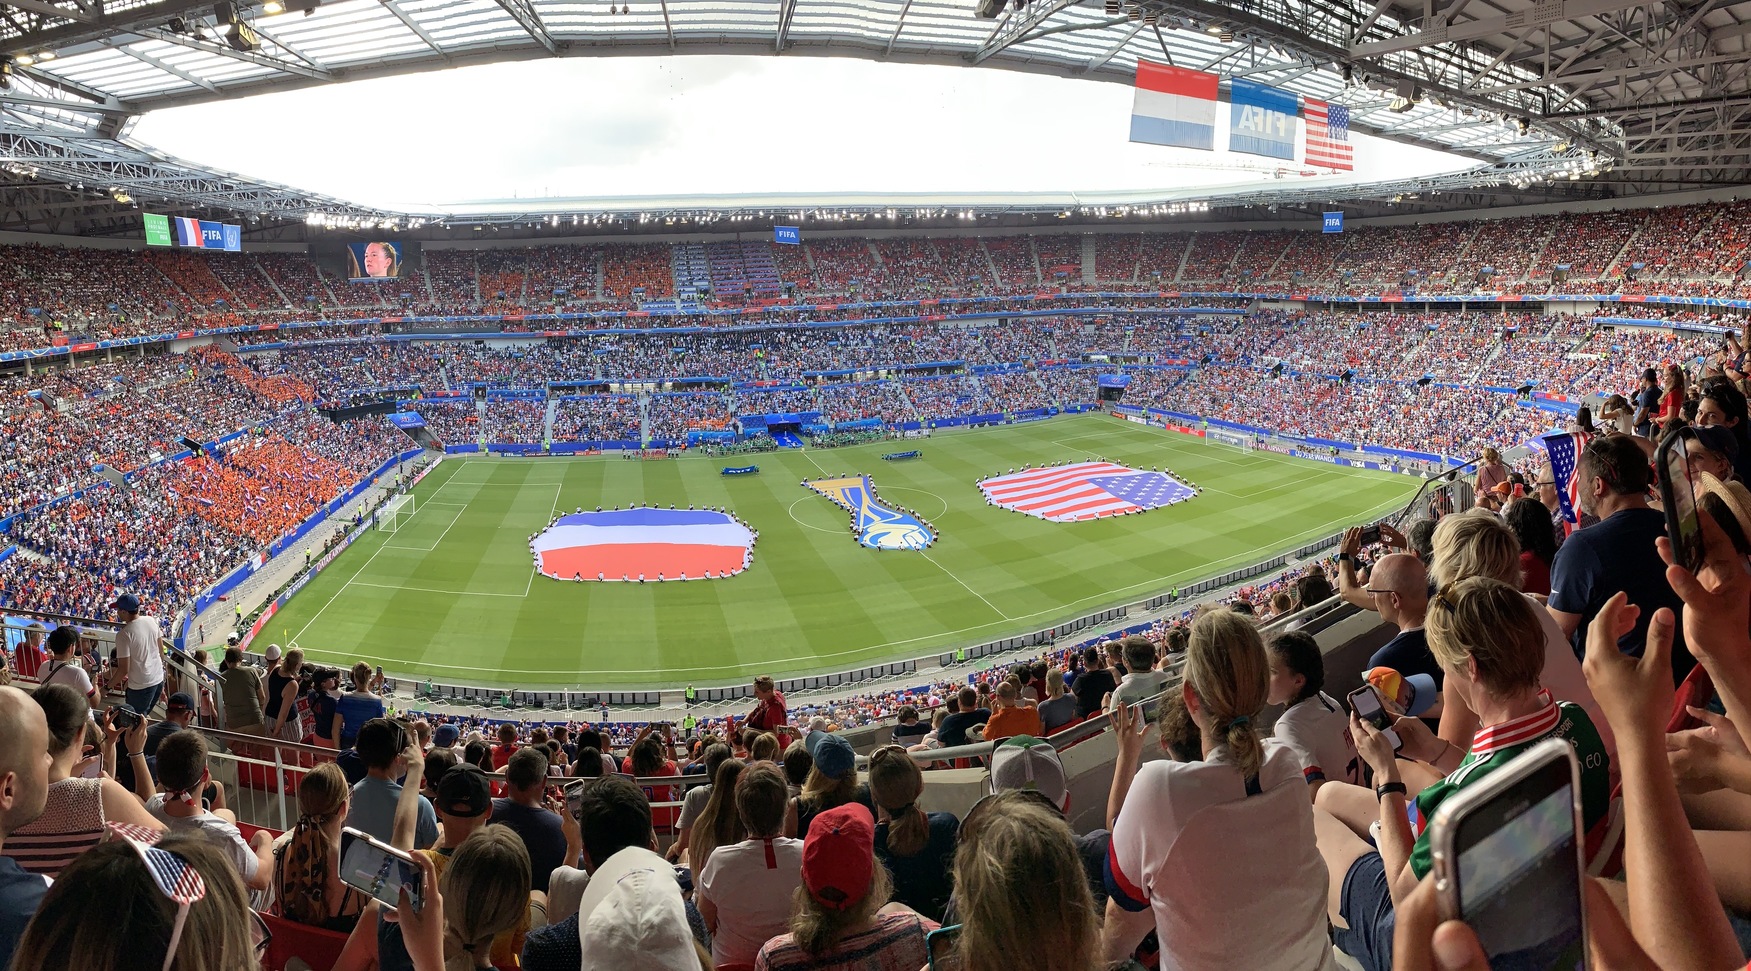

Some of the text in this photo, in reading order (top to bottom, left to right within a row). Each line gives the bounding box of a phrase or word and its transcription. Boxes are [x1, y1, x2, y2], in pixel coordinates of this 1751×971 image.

[1325, 218, 1340, 227] FIFA
[202, 230, 222, 241] FIFA
[779, 231, 796, 239] FIFA
[1266, 444, 1290, 455] AIRWAYS
[1315, 454, 1336, 464] WANDA
[1350, 460, 1366, 469] VISA
[1378, 463, 1393, 472] VISA
